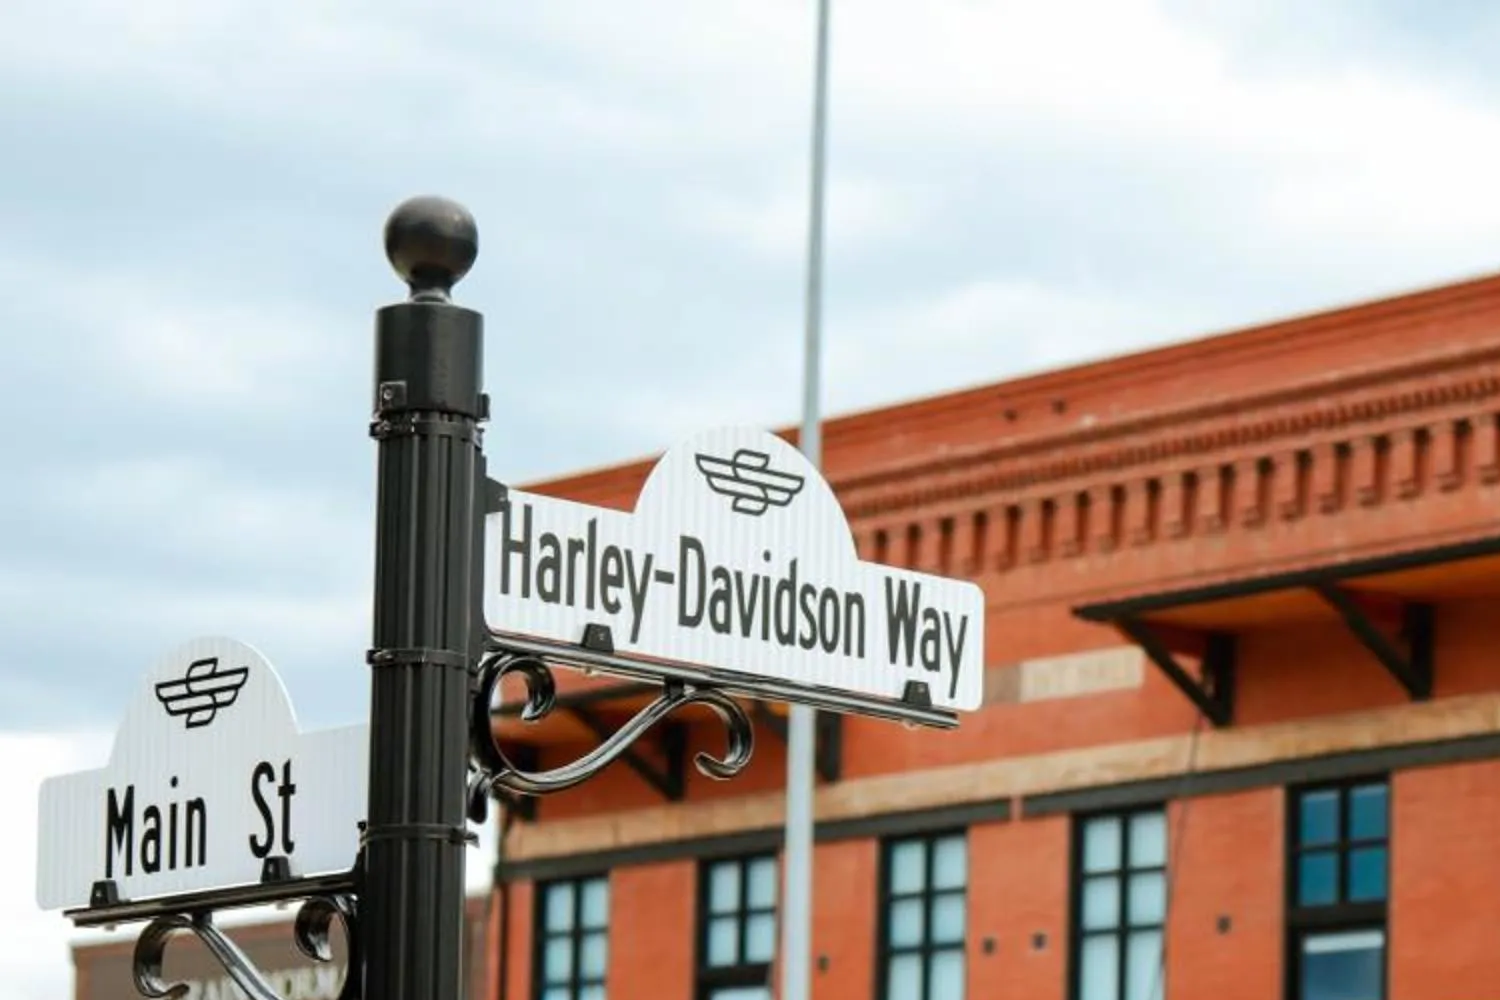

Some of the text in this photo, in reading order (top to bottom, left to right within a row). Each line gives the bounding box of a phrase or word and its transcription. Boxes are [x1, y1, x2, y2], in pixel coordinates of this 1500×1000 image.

[501, 504, 968, 699] Harley-Davidson Way
[105, 759, 296, 878] Main St
